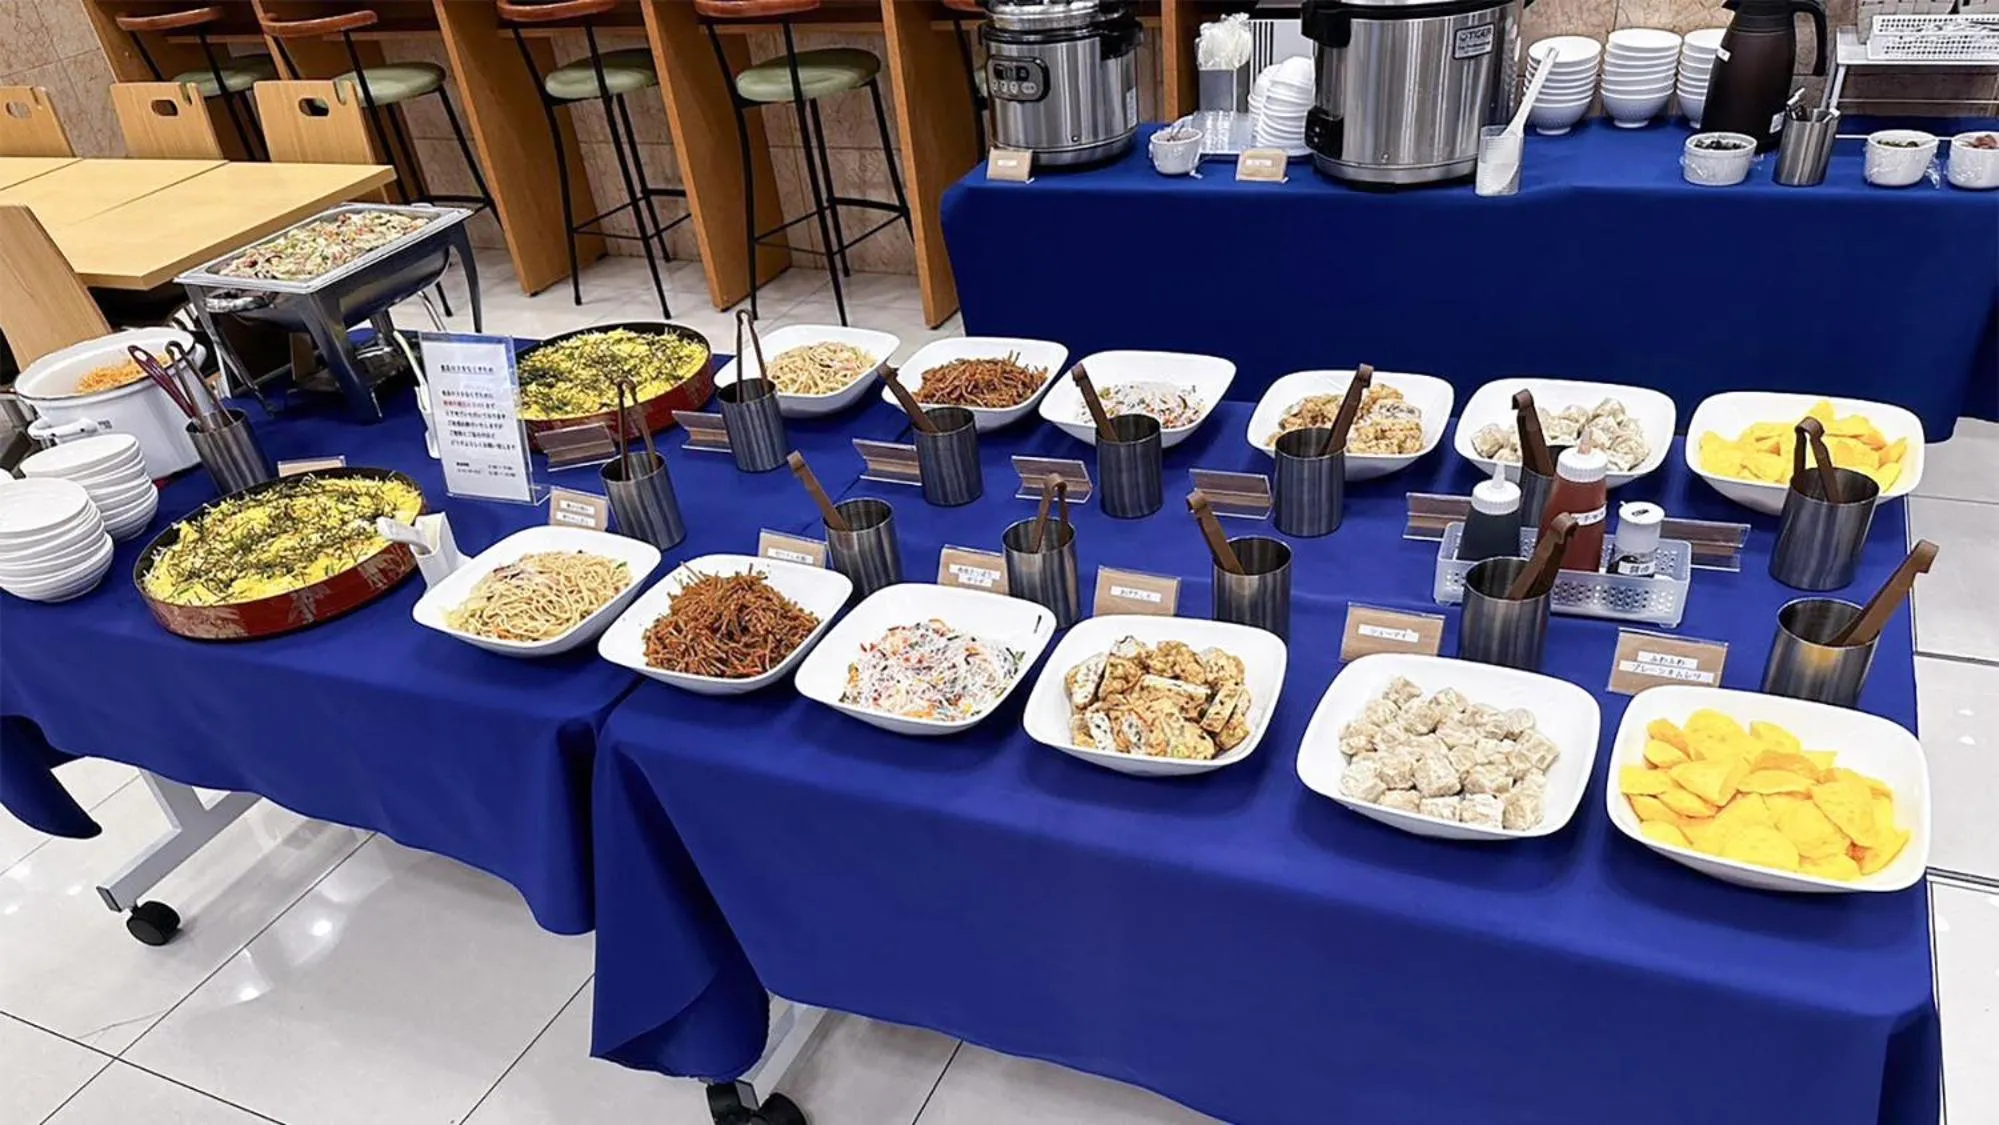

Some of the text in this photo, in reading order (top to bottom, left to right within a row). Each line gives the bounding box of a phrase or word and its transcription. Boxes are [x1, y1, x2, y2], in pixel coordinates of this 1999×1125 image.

[1468, 27, 1491, 40] TIGER
[1650, 655, 1685, 665] ふわふわ
[1632, 663, 1702, 679] プレーンオムレツ
